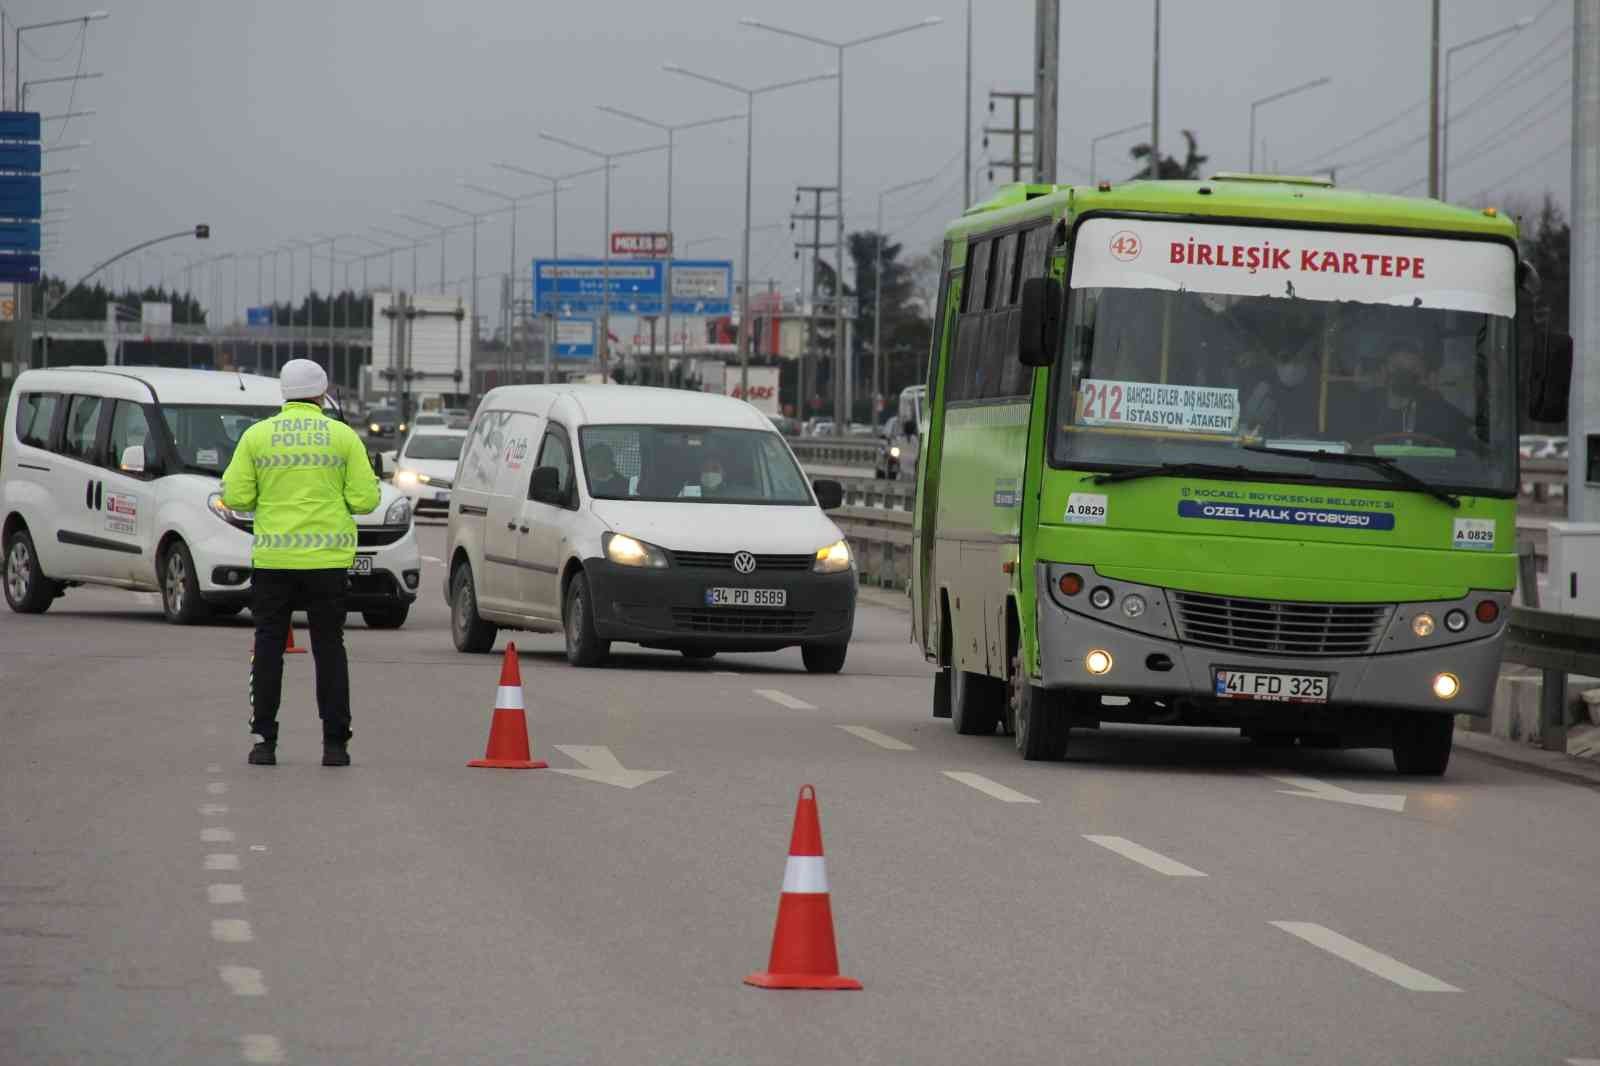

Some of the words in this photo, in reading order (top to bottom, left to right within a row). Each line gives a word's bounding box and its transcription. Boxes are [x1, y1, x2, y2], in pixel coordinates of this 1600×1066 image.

[1112, 237, 1138, 255] 42
[1169, 237, 1291, 273] BİRLEŞİK
[1300, 249, 1426, 279] KARTEPE
[1083, 383, 1123, 420] 212
[1157, 388, 1179, 406] EVLER
[1191, 413, 1233, 429] ATAKENT
[1066, 505, 1075, 514] A
[1078, 505, 1105, 516] 0829
[1248, 507, 1291, 520] HALK
[1294, 511, 1370, 526] OTOBÜSÜ
[1456, 530, 1464, 539] A
[1467, 531, 1493, 540] 0829
[713, 589, 728, 602] 34
[1226, 673, 1245, 692] 41
[1254, 676, 1281, 694] FD
[1289, 678, 1324, 696] 325
